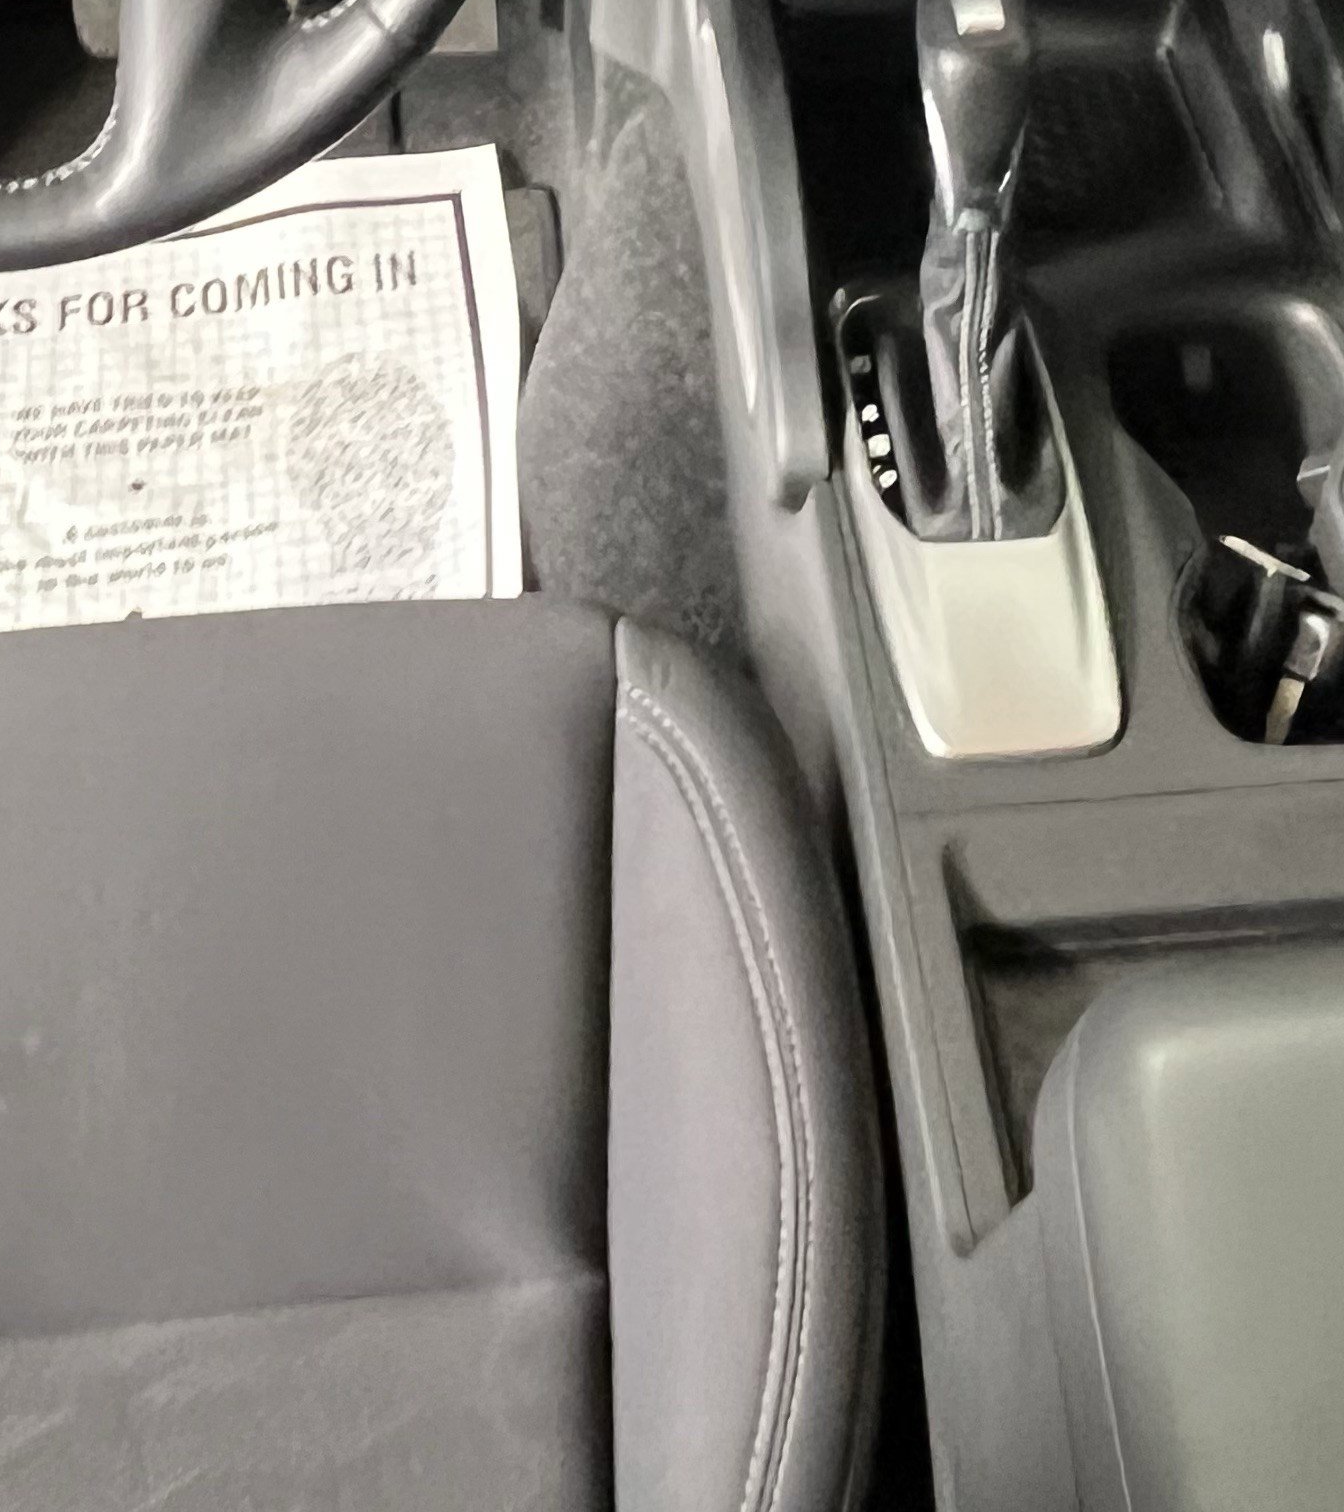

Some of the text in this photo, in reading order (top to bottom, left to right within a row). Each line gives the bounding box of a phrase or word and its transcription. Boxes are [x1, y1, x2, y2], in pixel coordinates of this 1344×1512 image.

[58, 288, 149, 332] FOR
[170, 254, 354, 318] COMING
[373, 249, 417, 293] IN
